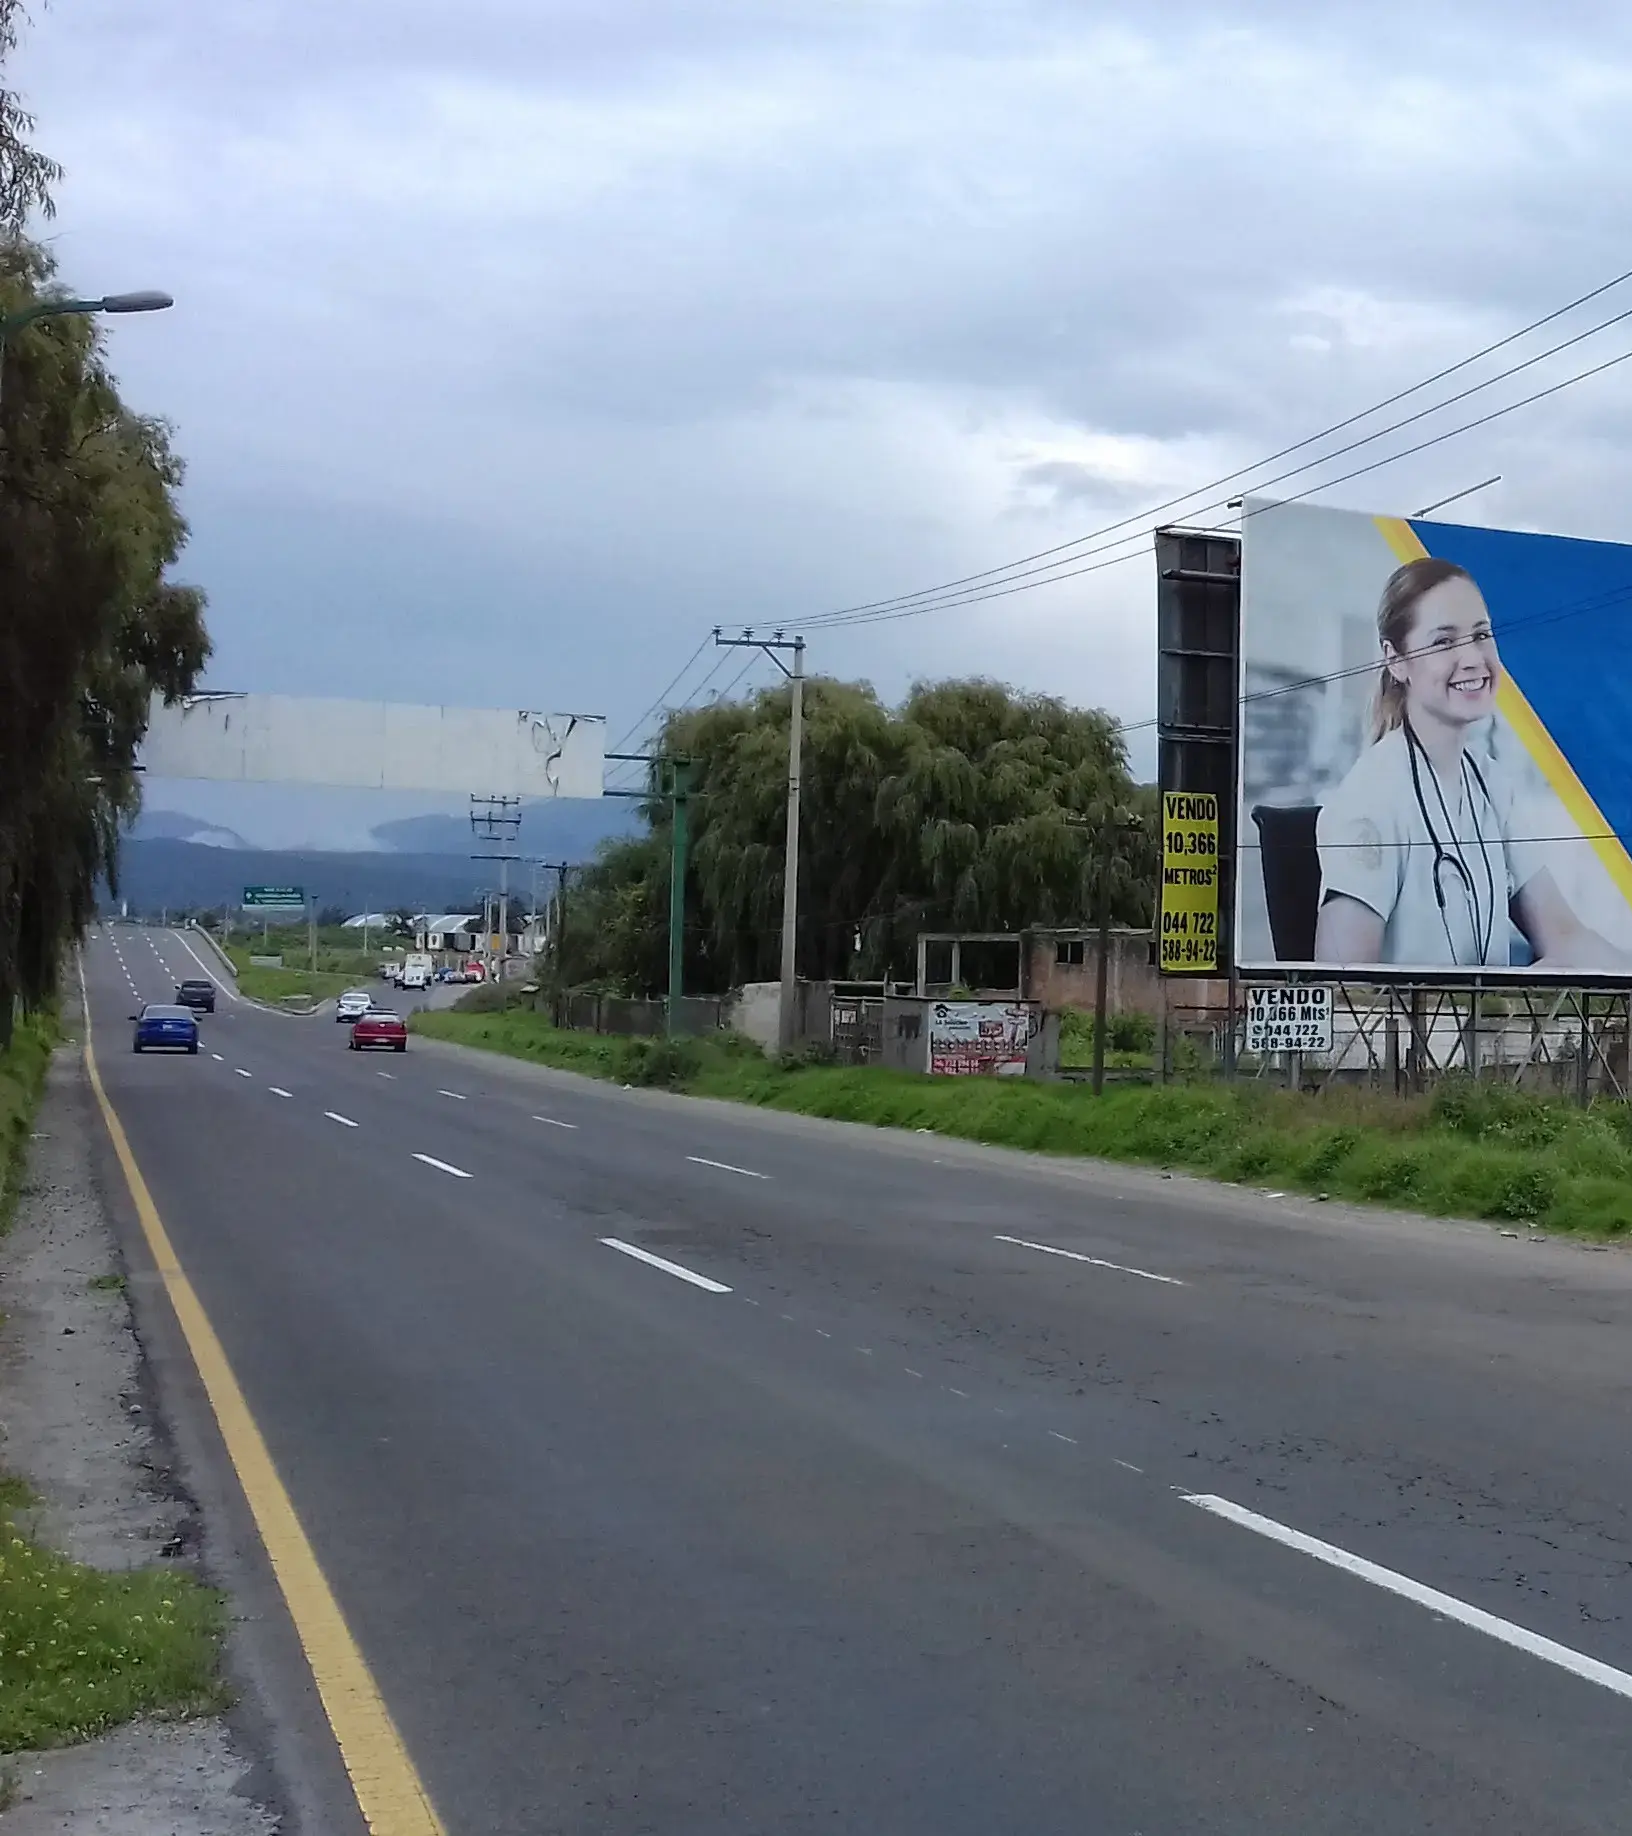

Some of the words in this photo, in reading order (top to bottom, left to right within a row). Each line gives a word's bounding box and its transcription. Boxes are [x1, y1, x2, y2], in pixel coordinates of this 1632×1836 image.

[1166, 796, 1216, 821] VENDO
[1166, 831, 1216, 856] 10,366
[1163, 911, 1188, 934] 044
[1192, 911, 1215, 934] 722
[1162, 938, 1216, 962] 588-94-22
[1252, 989, 1325, 1005] VENDO
[1294, 1024, 1319, 1037] 722
[1251, 1036, 1326, 1049] 588-94-22
